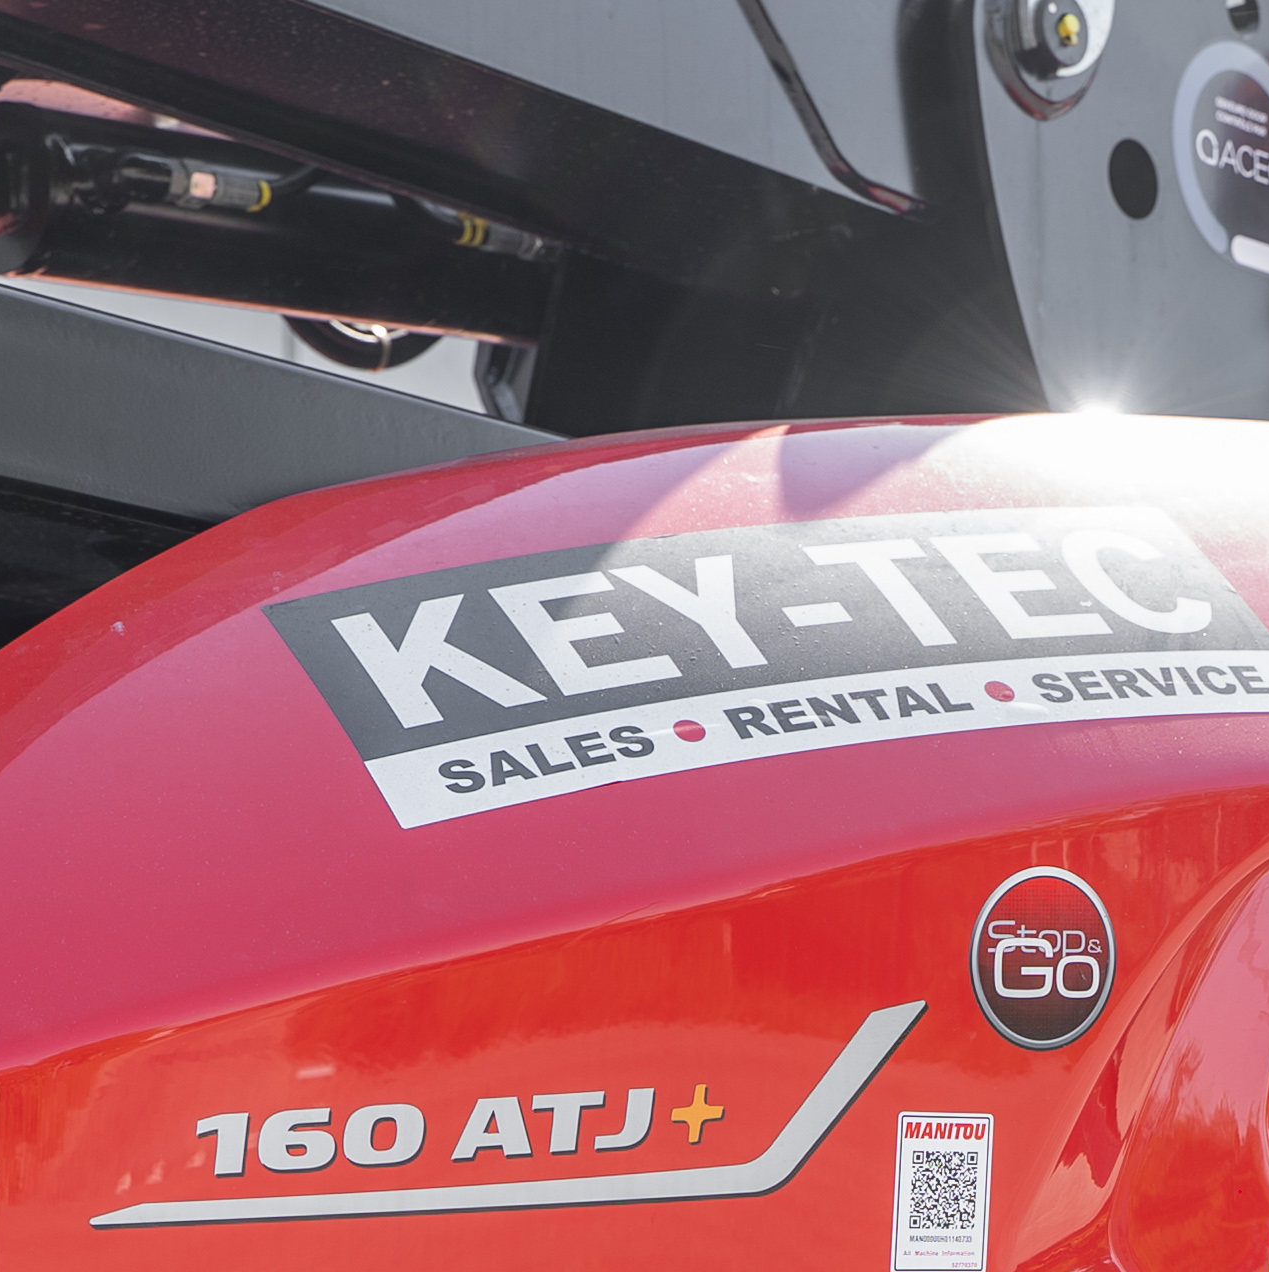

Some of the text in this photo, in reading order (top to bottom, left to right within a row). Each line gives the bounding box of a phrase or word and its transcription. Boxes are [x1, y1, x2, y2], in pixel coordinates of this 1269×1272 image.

[330, 529, 1213, 730] KEY-TEC
[437, 723, 656, 795] SALES
[721, 681, 974, 741] RENTAL
[987, 920, 1103, 958] Stop &
[994, 937, 1100, 999] Go
[194, 1103, 427, 1178] 160
[904, 1122, 986, 1140] MANITOU
